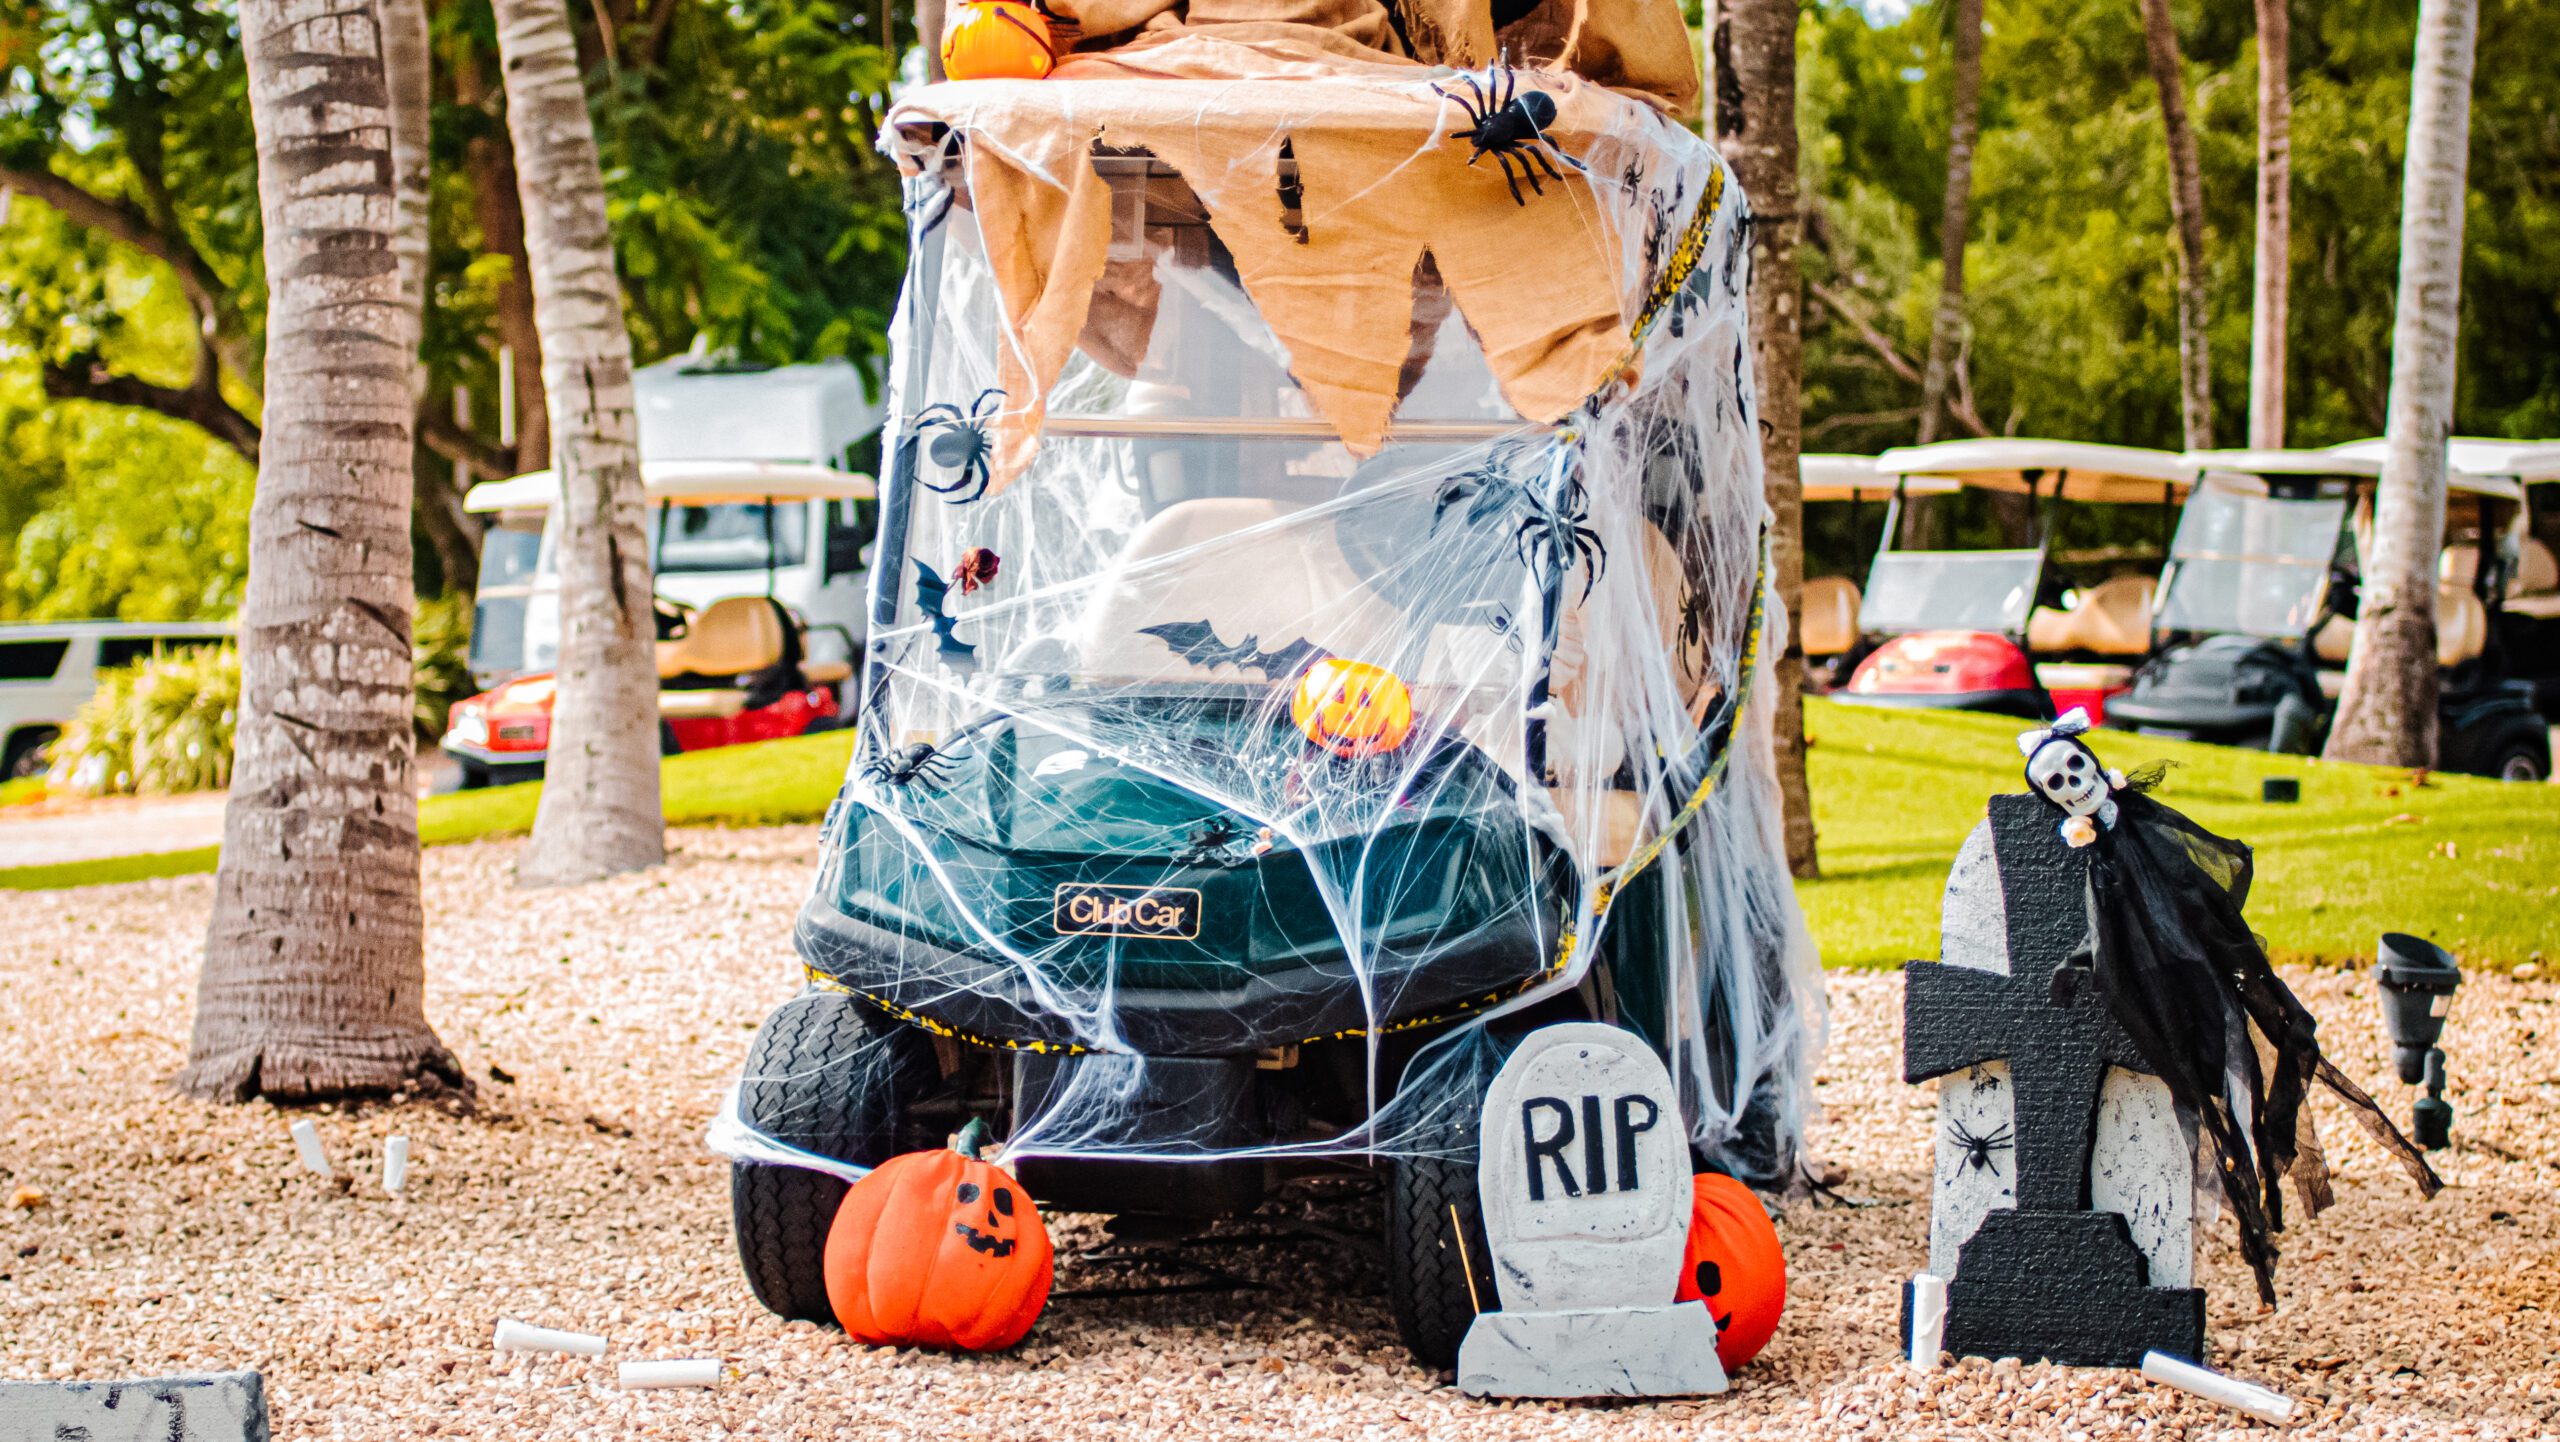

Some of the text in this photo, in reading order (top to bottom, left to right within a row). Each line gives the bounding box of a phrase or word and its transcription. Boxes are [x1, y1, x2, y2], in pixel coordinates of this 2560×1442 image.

[1070, 895, 1185, 927] Club Car
[1522, 1094, 1658, 1201] RIP
